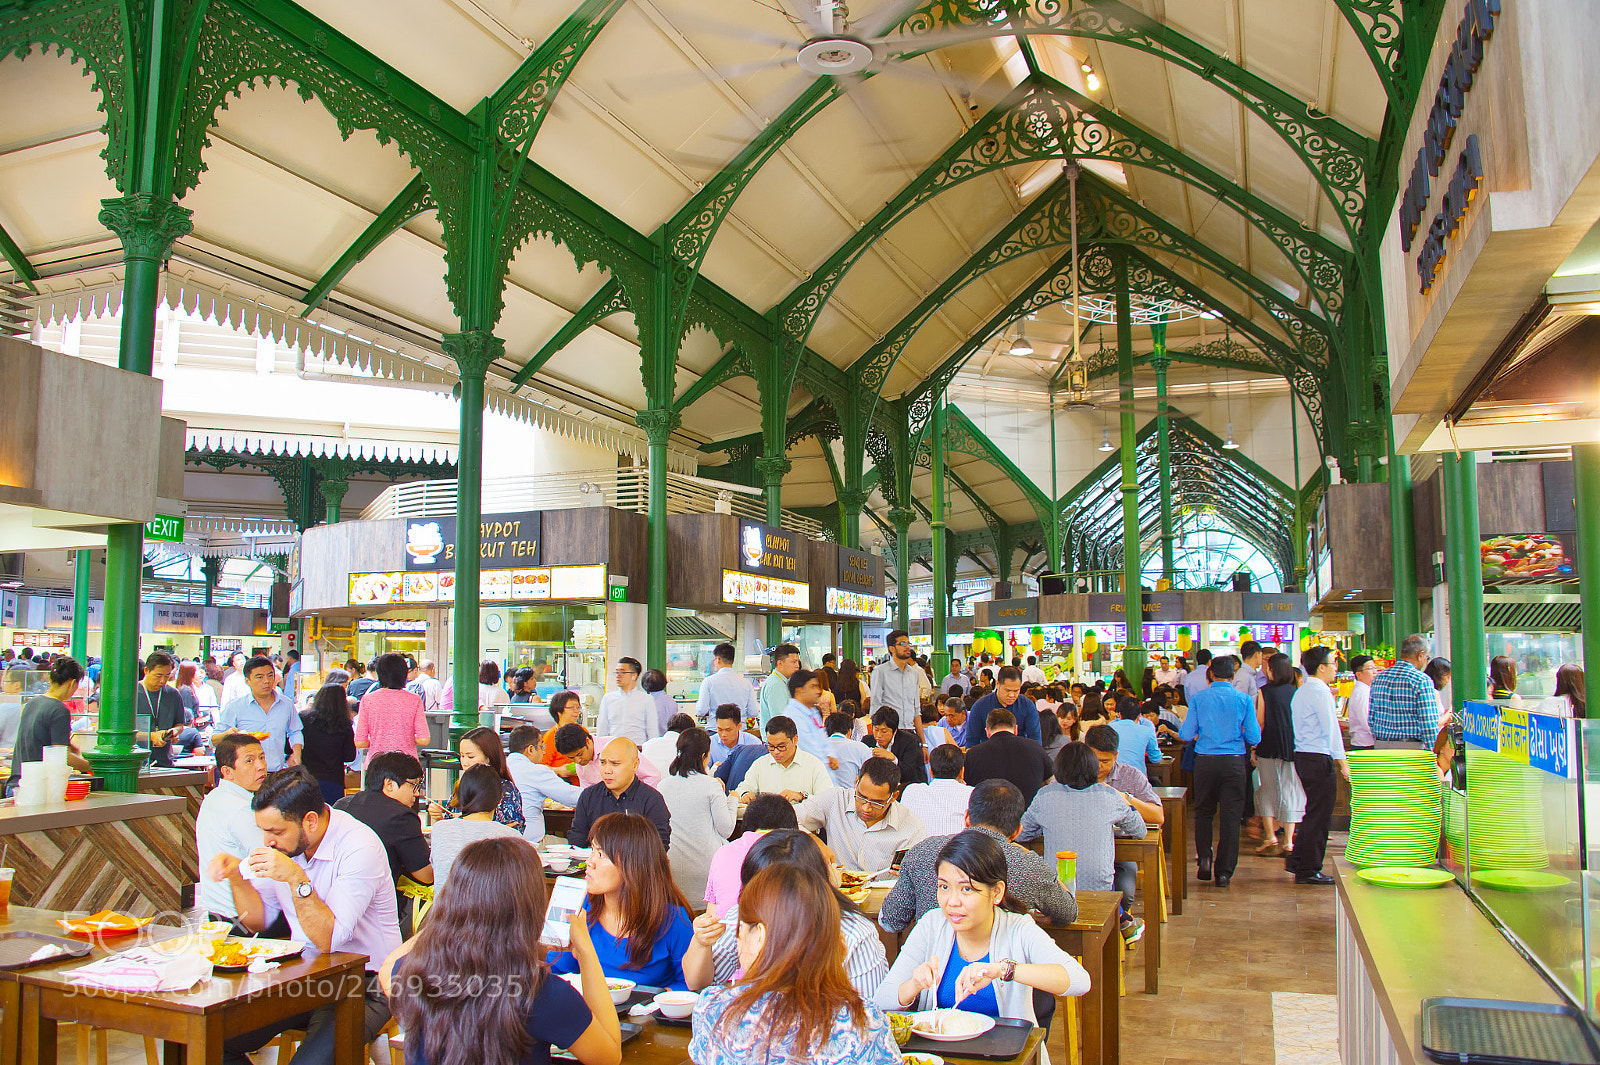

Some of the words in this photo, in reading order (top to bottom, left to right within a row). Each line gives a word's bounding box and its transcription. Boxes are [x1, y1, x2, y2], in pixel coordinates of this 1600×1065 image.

[153, 518, 179, 537] EXIT
[511, 540, 537, 557] TEH
[765, 533, 790, 552] CLAYPOT
[785, 556, 796, 571] TEH
[614, 588, 625, 599] EXIT
[57, 604, 71, 612] THAI
[1110, 603, 1126, 613] FRU
[1142, 602, 1162, 612] UICE
[1261, 602, 1273, 611] CUT
[1276, 602, 1293, 611] FRUIT
